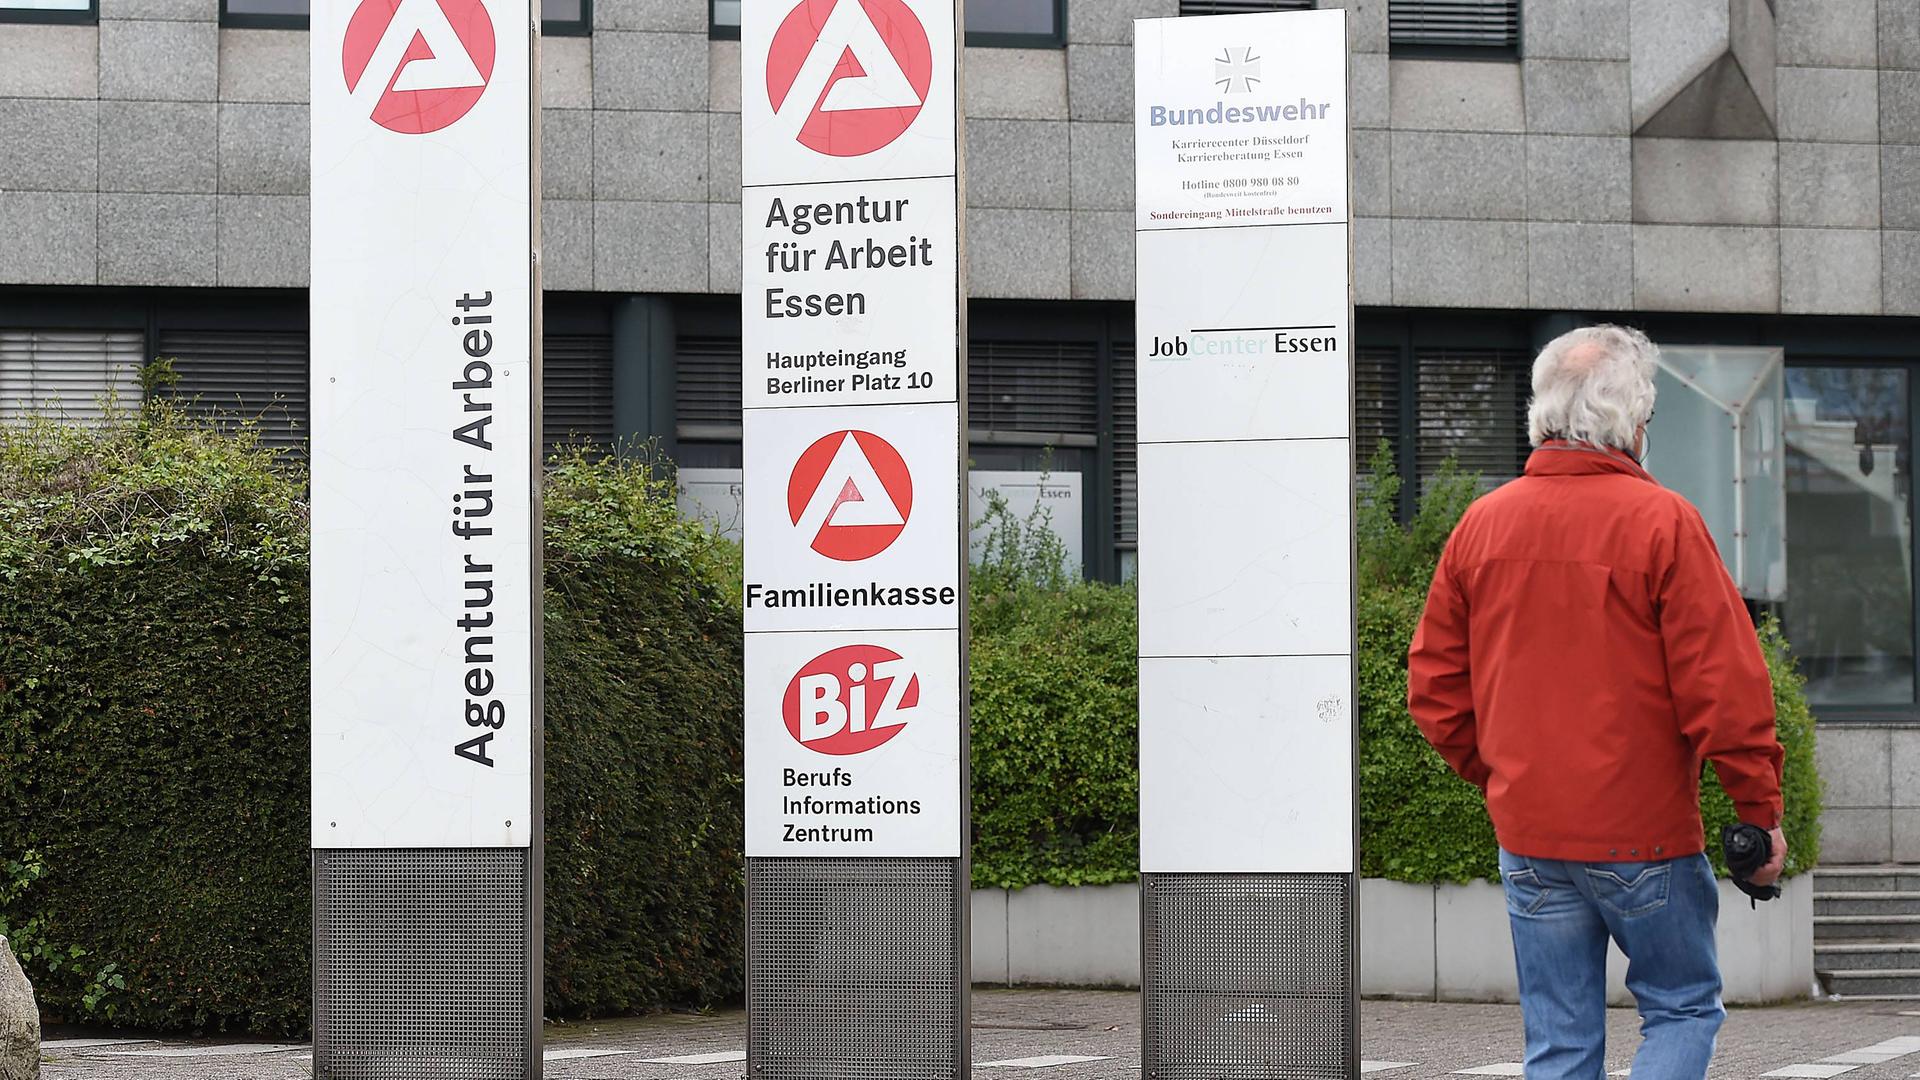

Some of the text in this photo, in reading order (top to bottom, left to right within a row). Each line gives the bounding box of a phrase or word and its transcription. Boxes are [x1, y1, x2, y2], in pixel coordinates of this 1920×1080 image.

[1150, 98, 1331, 127] Bundeswehr
[1172, 135, 1311, 150] Karrierecenter Düsseldorf
[1177, 149, 1304, 162] Karriereberatung Essen
[1182, 176, 1300, 191] Hotline 0800 980 08 80
[765, 195, 909, 235] Agentur
[1149, 203, 1333, 221] Sondereingang Mittelstraße benutzen
[765, 236, 933, 273] für Arbeit
[766, 287, 865, 319] Essen
[1274, 332, 1337, 354] Essen
[767, 349, 907, 371] Haupteingang
[767, 371, 934, 394] Berliner Platz 10
[451, 290, 504, 769] Agentur für Arbeit
[746, 582, 956, 609] Familienkasse
[799, 658, 919, 743] BiZ
[783, 767, 852, 787] Berufs
[783, 795, 921, 815] Informations
[782, 823, 873, 843] Zentrum
